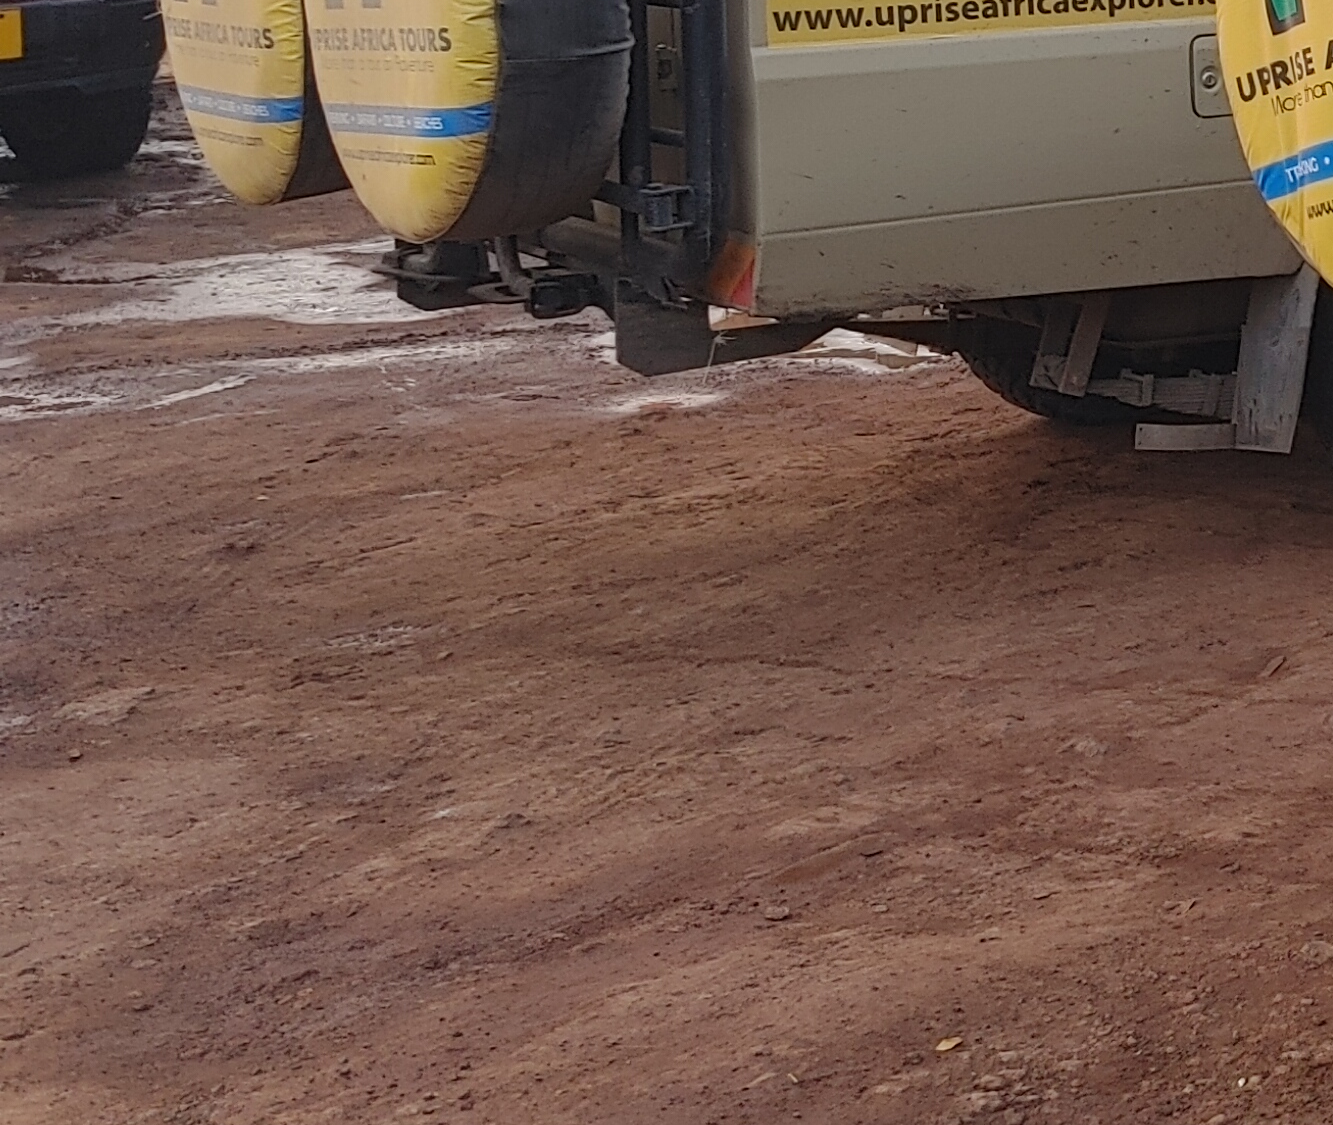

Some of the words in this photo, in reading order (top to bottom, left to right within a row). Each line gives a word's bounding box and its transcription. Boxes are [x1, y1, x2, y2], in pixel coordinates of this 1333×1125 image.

[315, 27, 349, 51] PRISE
[352, 27, 397, 51] AFRICA
[399, 27, 452, 53] TOURS
[1236, 47, 1316, 103] UPRISE
